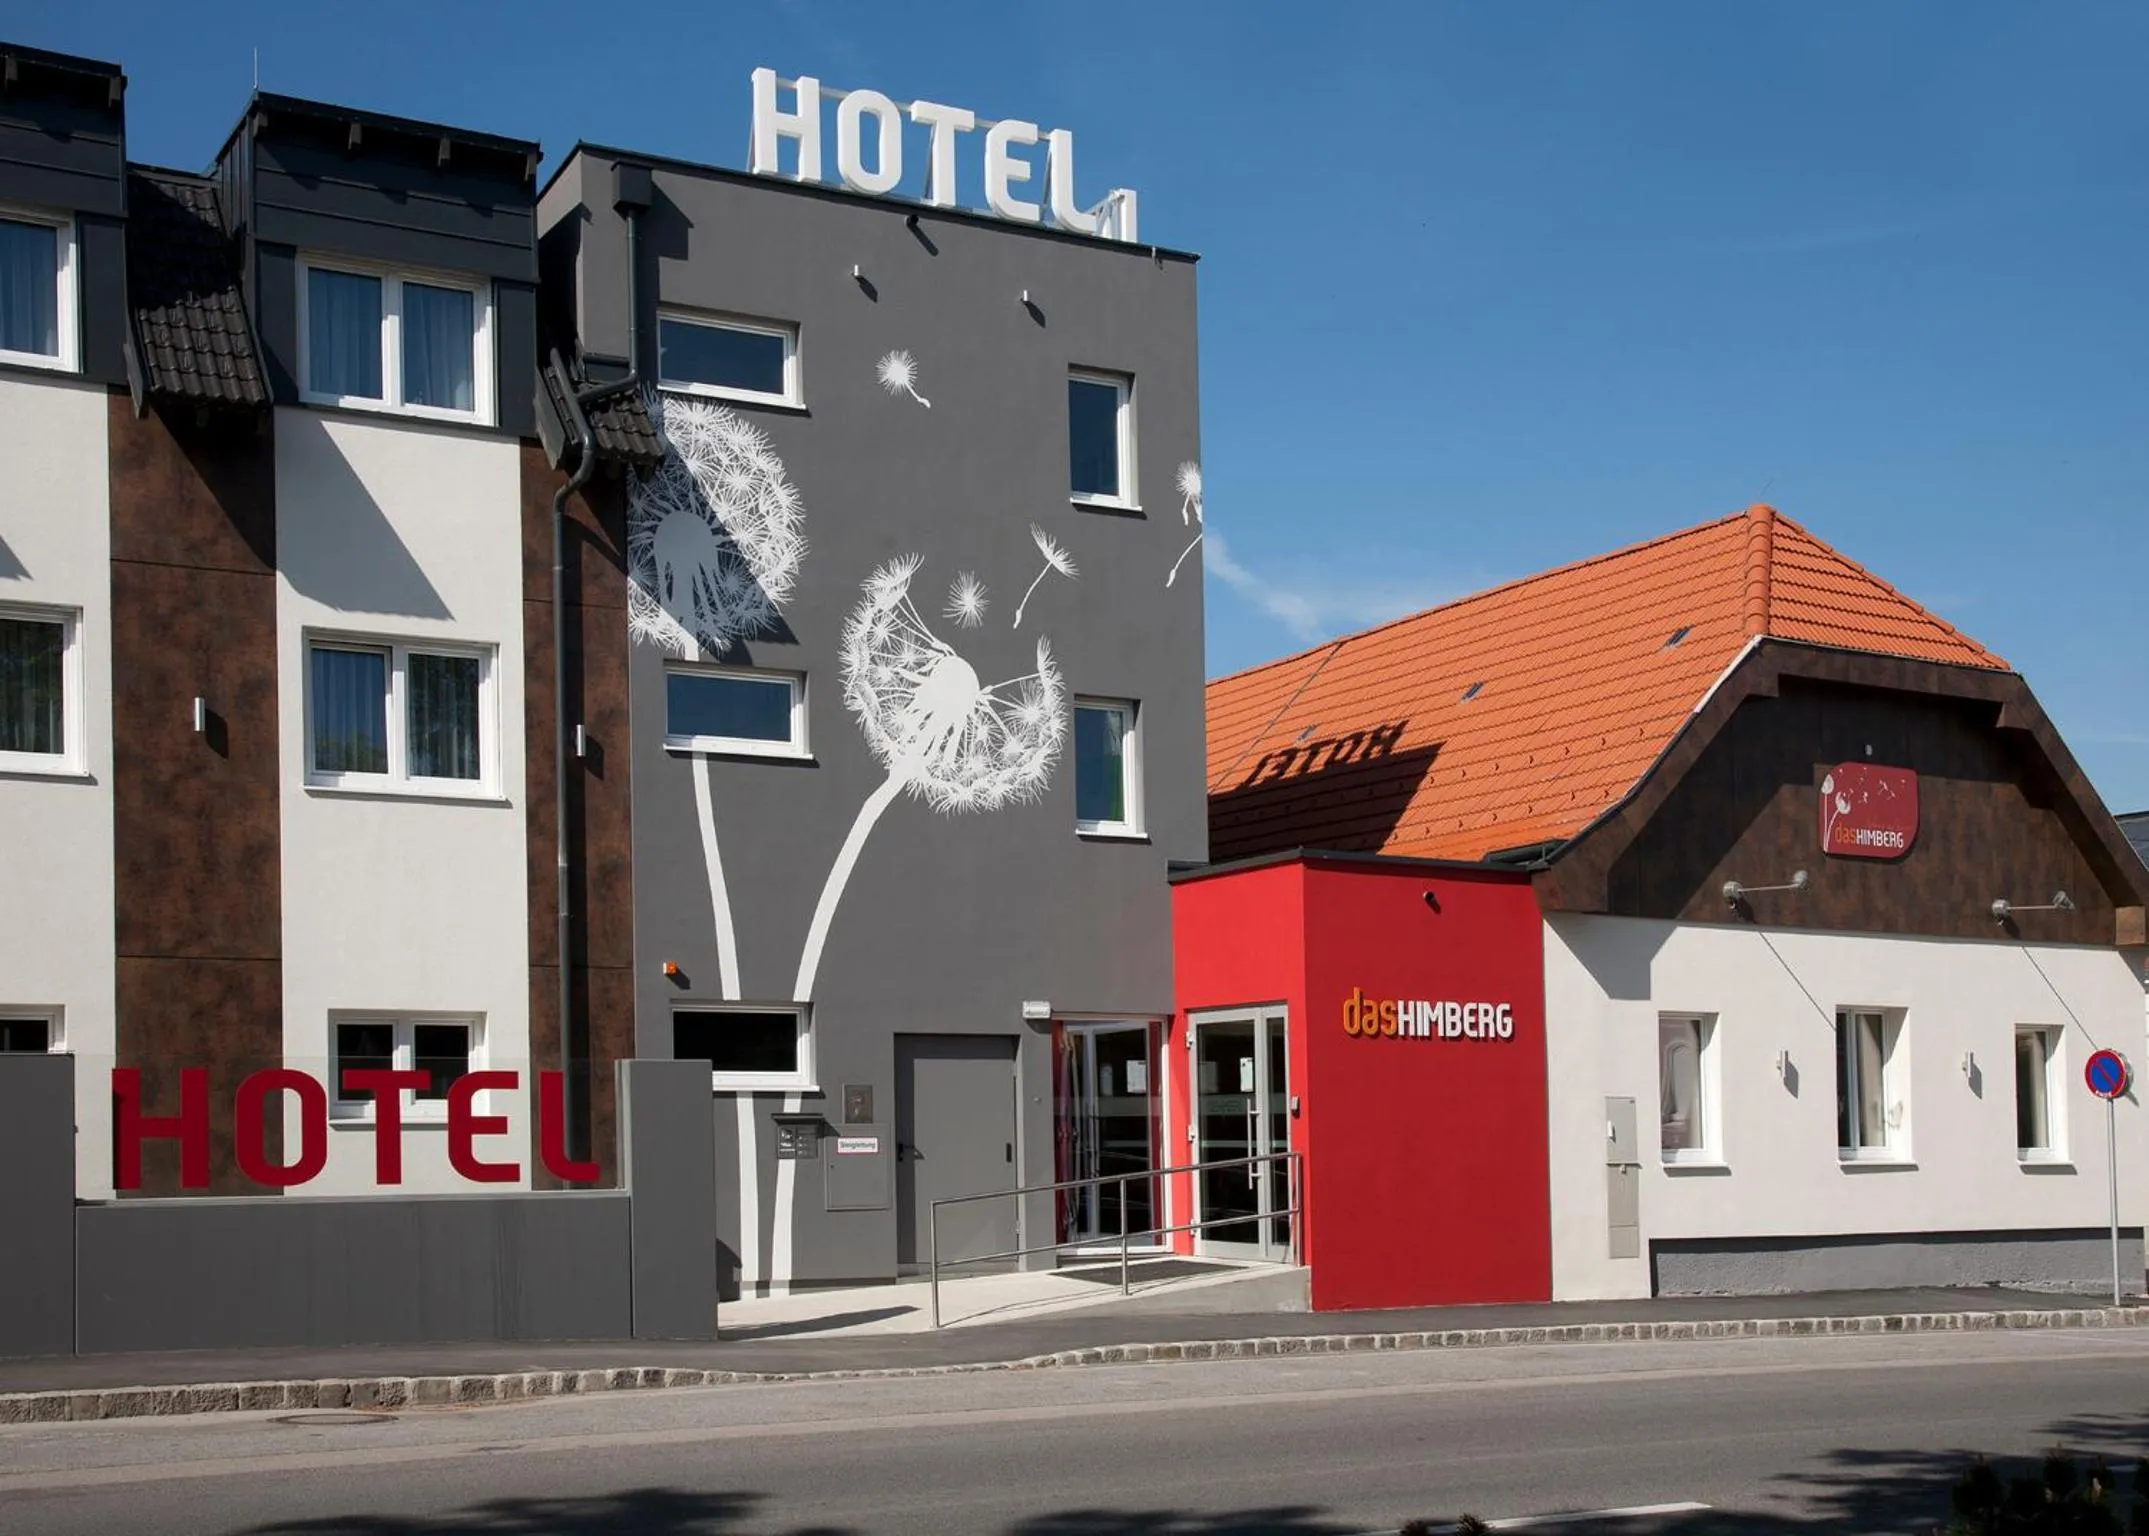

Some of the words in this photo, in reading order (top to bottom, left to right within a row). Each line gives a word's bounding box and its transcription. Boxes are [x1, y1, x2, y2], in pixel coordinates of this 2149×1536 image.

[751, 67, 1098, 234] HOTEL
[1835, 823, 1904, 848] dasHIMBERG
[1343, 986, 1513, 1038] dasHIMBERG
[112, 1067, 600, 1190] HOTEL
